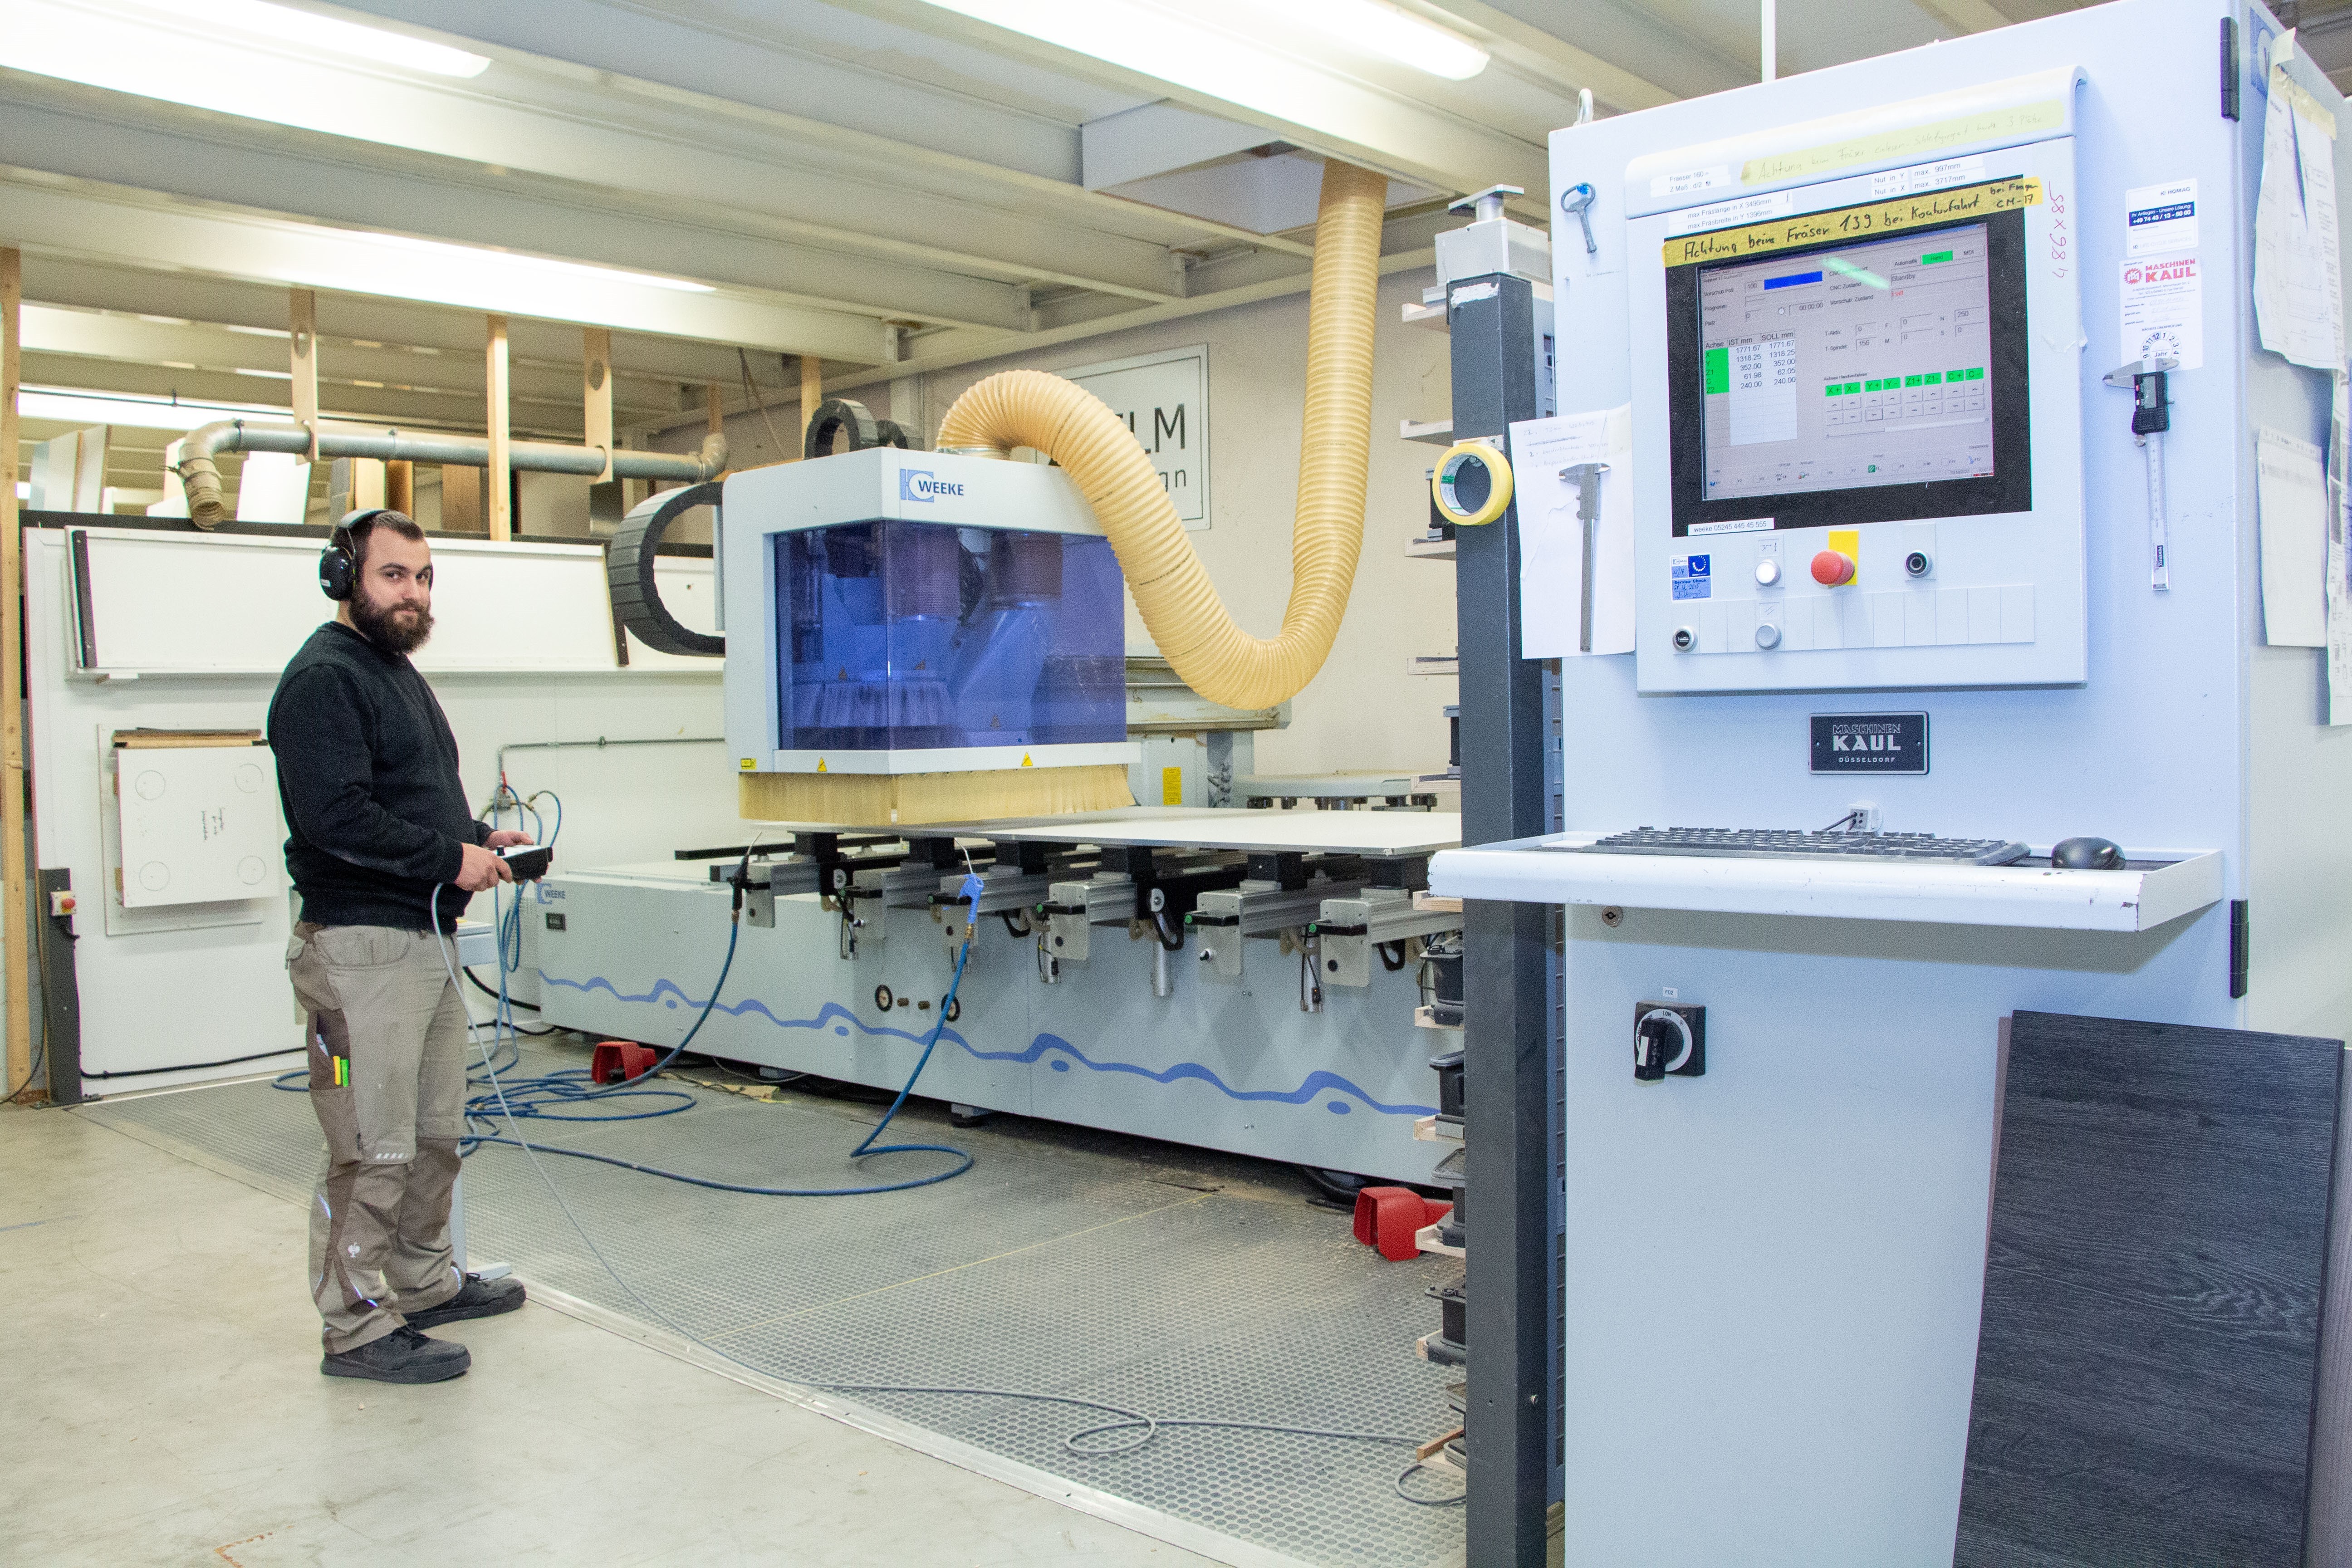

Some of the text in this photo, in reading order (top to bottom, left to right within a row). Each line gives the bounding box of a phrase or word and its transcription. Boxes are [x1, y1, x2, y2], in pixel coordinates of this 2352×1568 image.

[1935, 163, 1960, 172] 997mm
[1935, 175, 1965, 185] 3717mm
[1745, 198, 1771, 208] 3496mm
[1746, 209, 1772, 219] 1396mm
[1684, 237, 1737, 262] Achtung
[1787, 224, 1830, 242] Fräser
[1840, 214, 1872, 232] 139
[2145, 258, 2195, 271] MASCHINEN
[2145, 266, 2196, 283] KAUL
[1799, 302, 1823, 311] 00:00:00
[1728, 338, 1740, 346] IST
[1736, 345, 1761, 353] 1771.67
[1770, 340, 1795, 349] 1771.67
[1736, 353, 1761, 362] 1318.25
[1770, 349, 1795, 358] 1318.25
[1740, 363, 1762, 371] 352.00
[1774, 358, 1796, 367] 352.00
[1744, 372, 1762, 380] 61.98
[1906, 377, 1921, 385] Z1+
[1926, 375, 1939, 383] Z1-
[1740, 381, 1762, 389] 240.00
[1774, 377, 1796, 385] 240.00
[918, 480, 964, 496] WEEKE
[1833, 724, 1901, 734] MASCHINEN
[1833, 735, 1901, 751] KAUL
[545, 890, 565, 899] WEEKE
